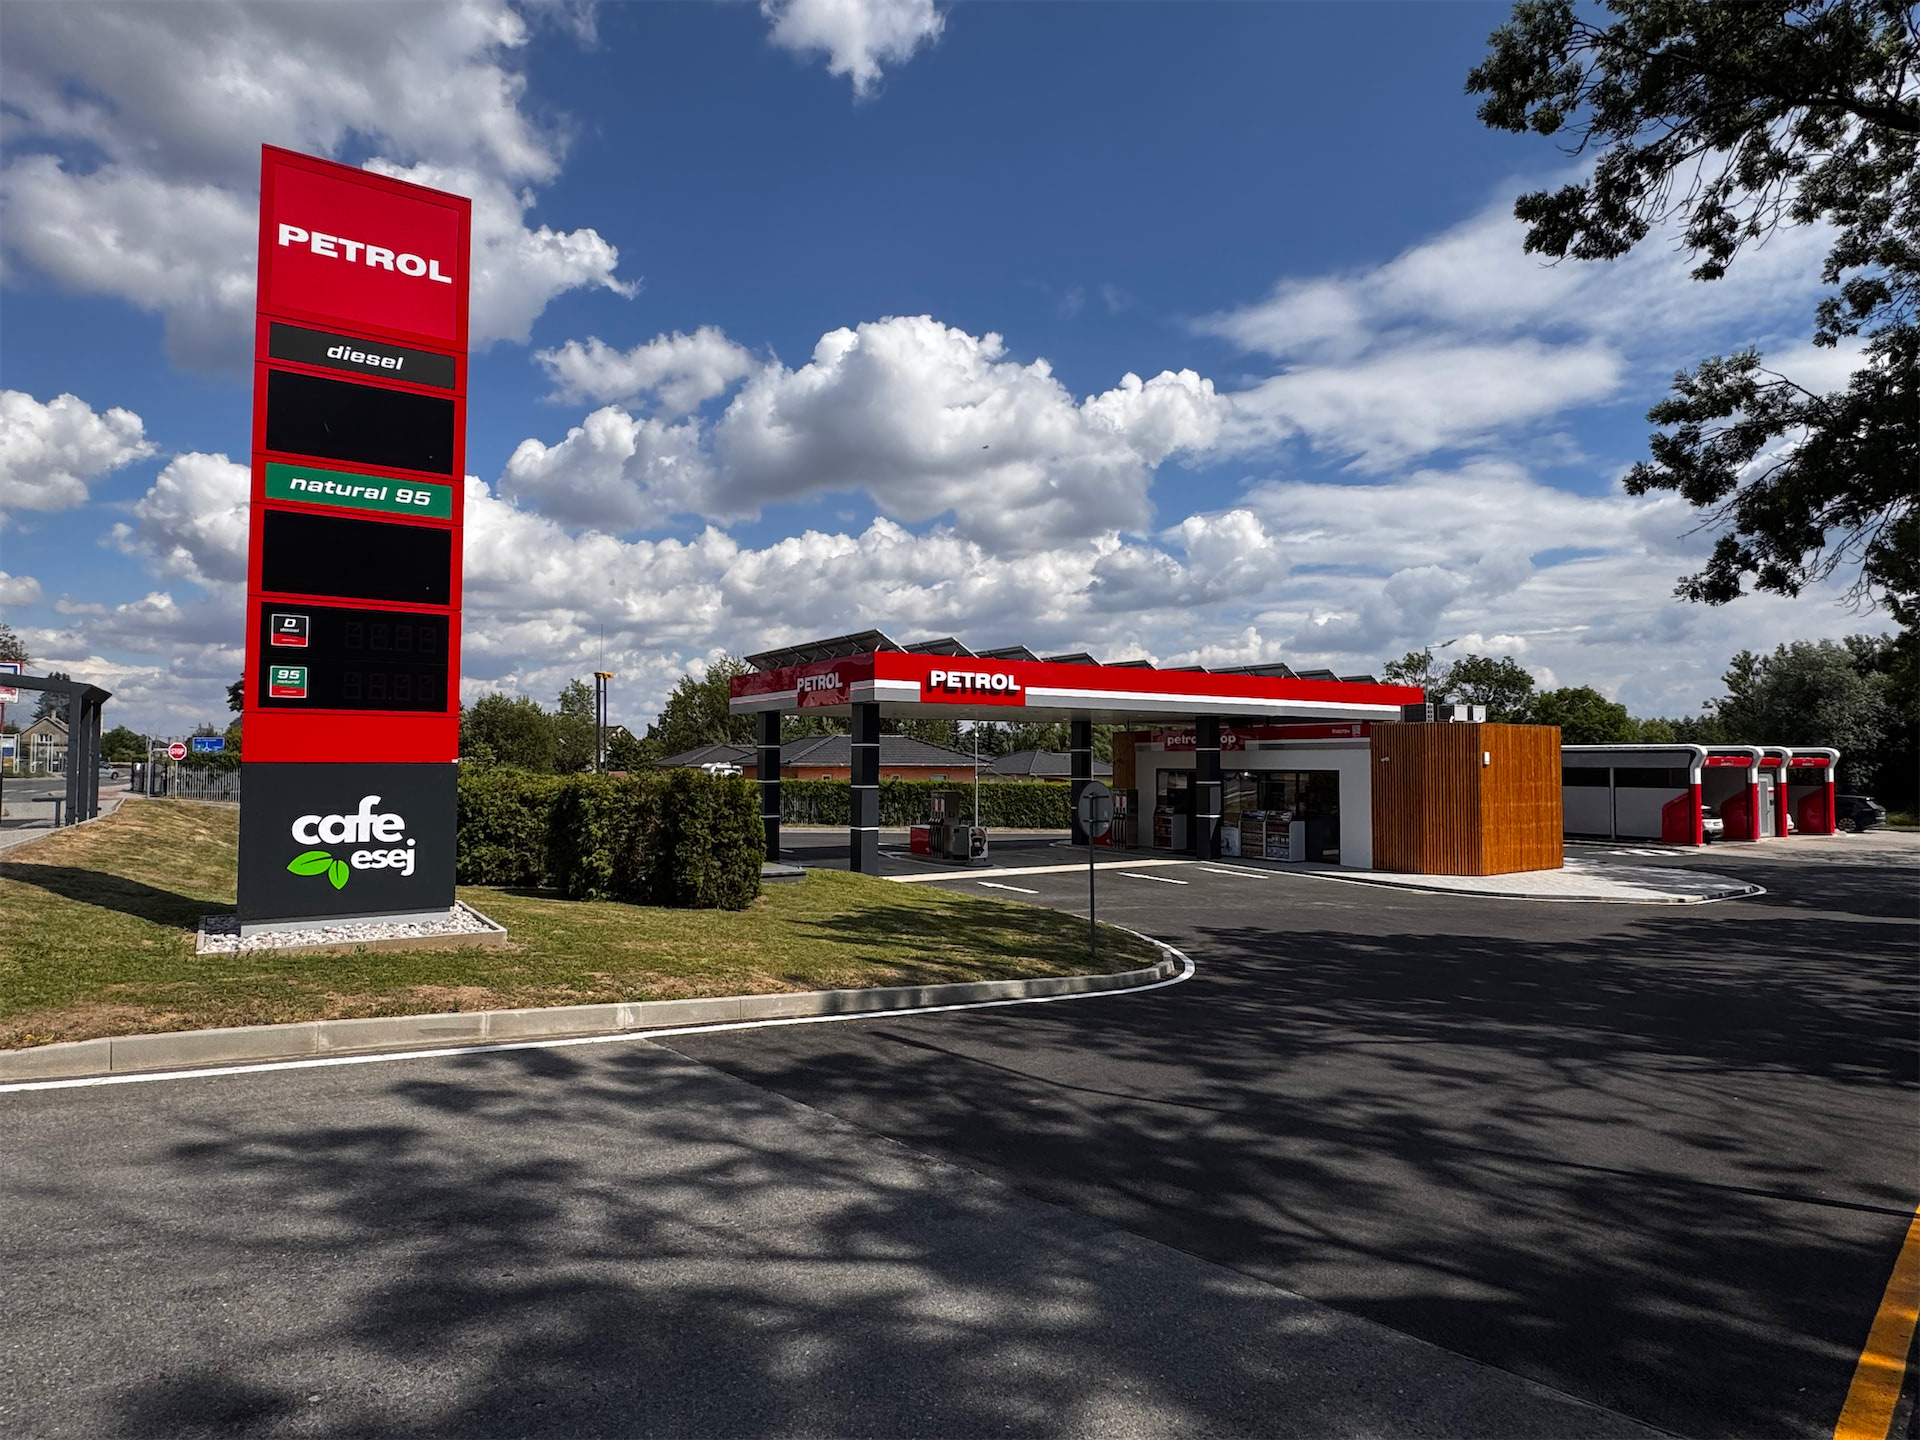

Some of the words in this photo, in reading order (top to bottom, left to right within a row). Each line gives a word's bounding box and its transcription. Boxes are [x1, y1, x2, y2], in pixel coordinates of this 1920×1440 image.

[278, 223, 452, 284] PETROL
[327, 345, 403, 371] diesel
[289, 477, 388, 501] natural
[395, 489, 432, 506] 95
[283, 618, 297, 628] D
[277, 669, 301, 680] 95
[796, 671, 843, 693] PETROL
[930, 669, 1021, 691] PETROL
[1167, 734, 1197, 746] petro
[291, 794, 406, 845] cafe
[351, 838, 417, 877] esej
